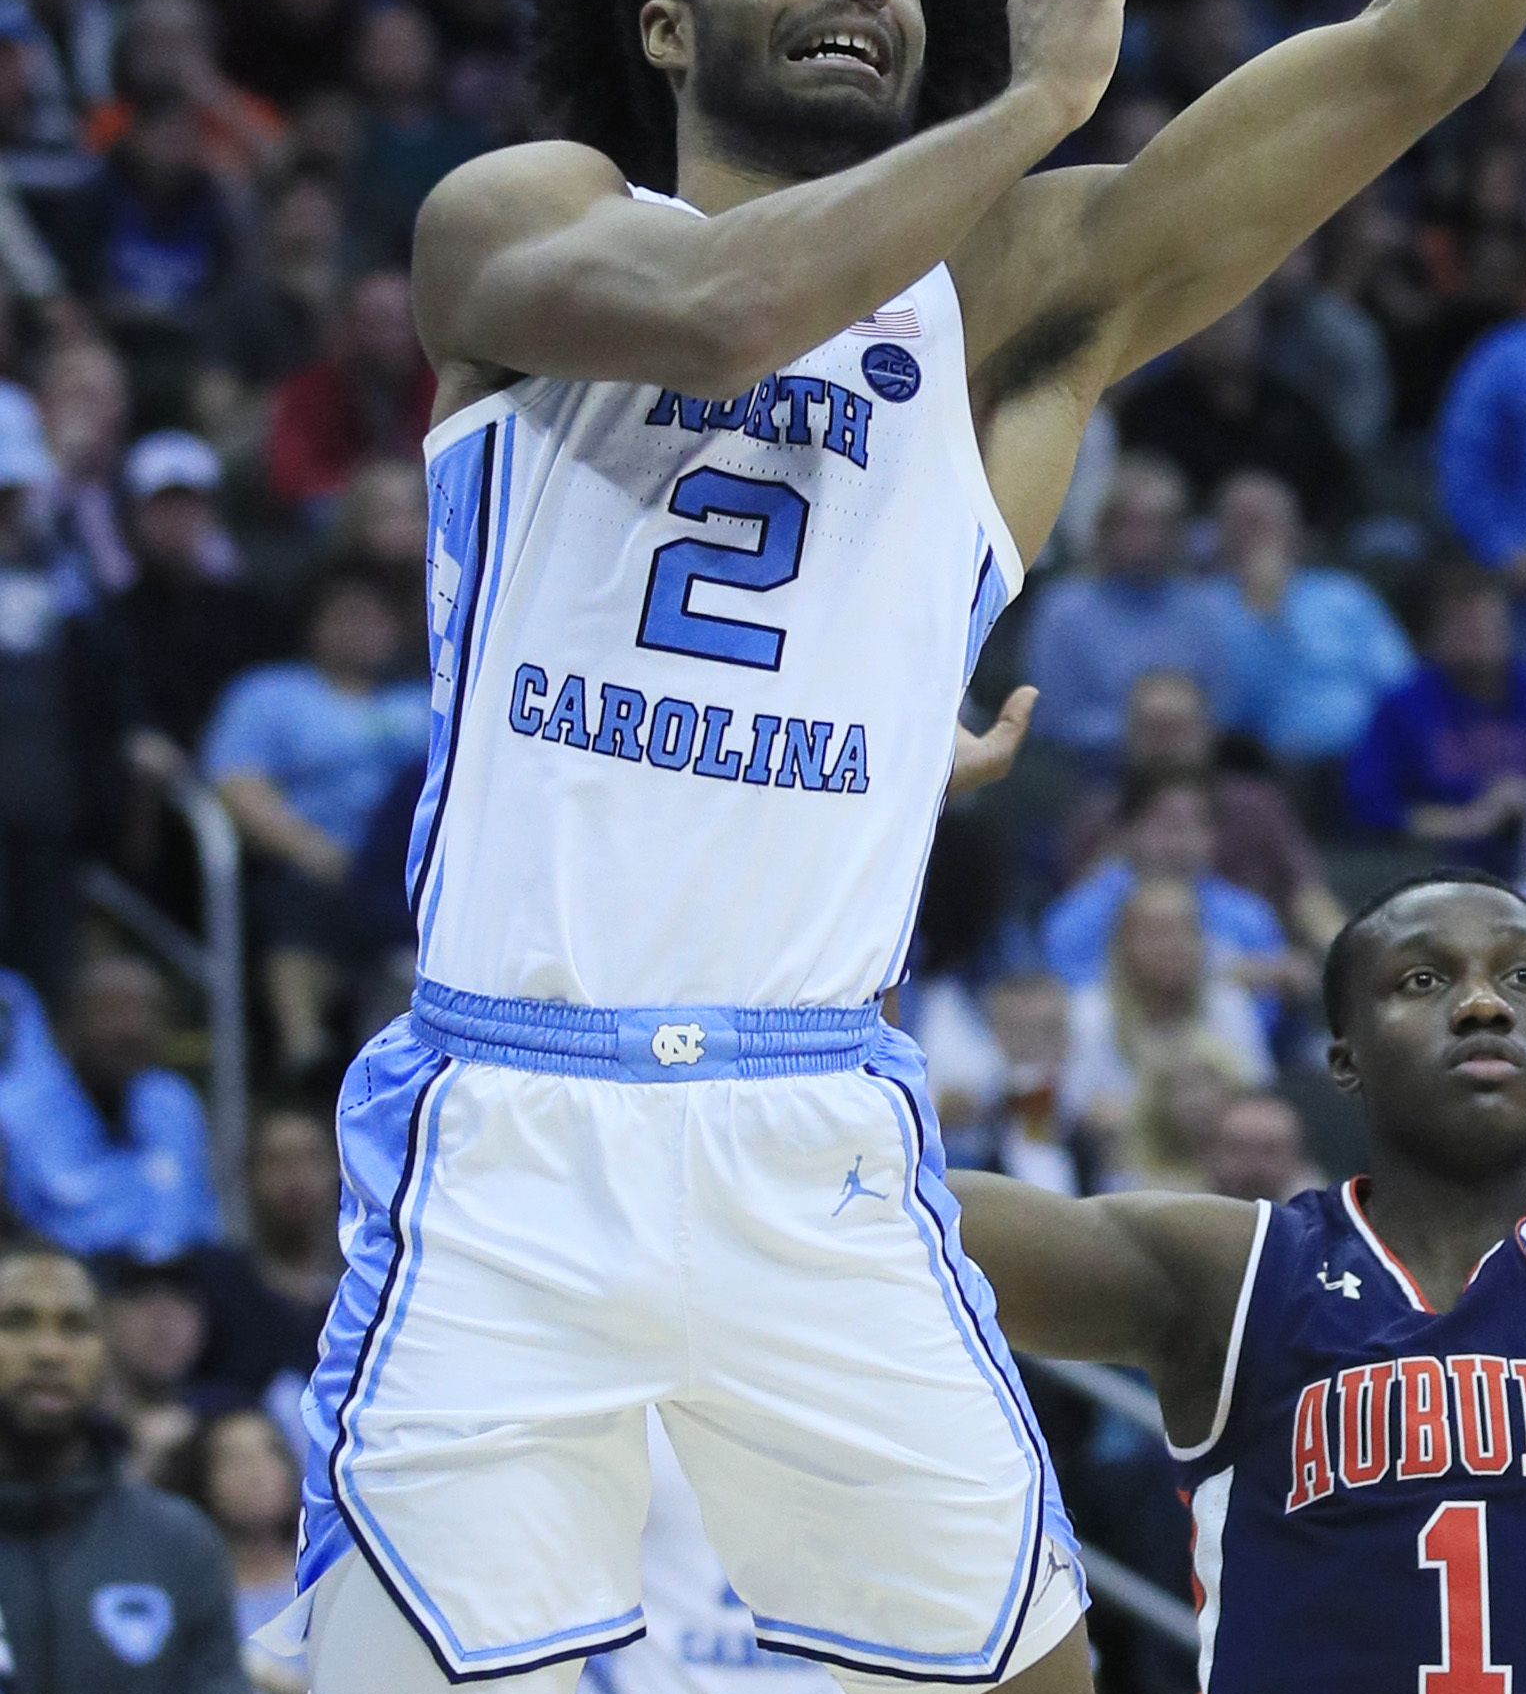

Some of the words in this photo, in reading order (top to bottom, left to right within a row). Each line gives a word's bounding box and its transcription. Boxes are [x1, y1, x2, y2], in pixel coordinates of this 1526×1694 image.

[870, 358, 916, 379] ACC
[636, 464, 811, 671] 2
[508, 662, 870, 794] CAROLINA
